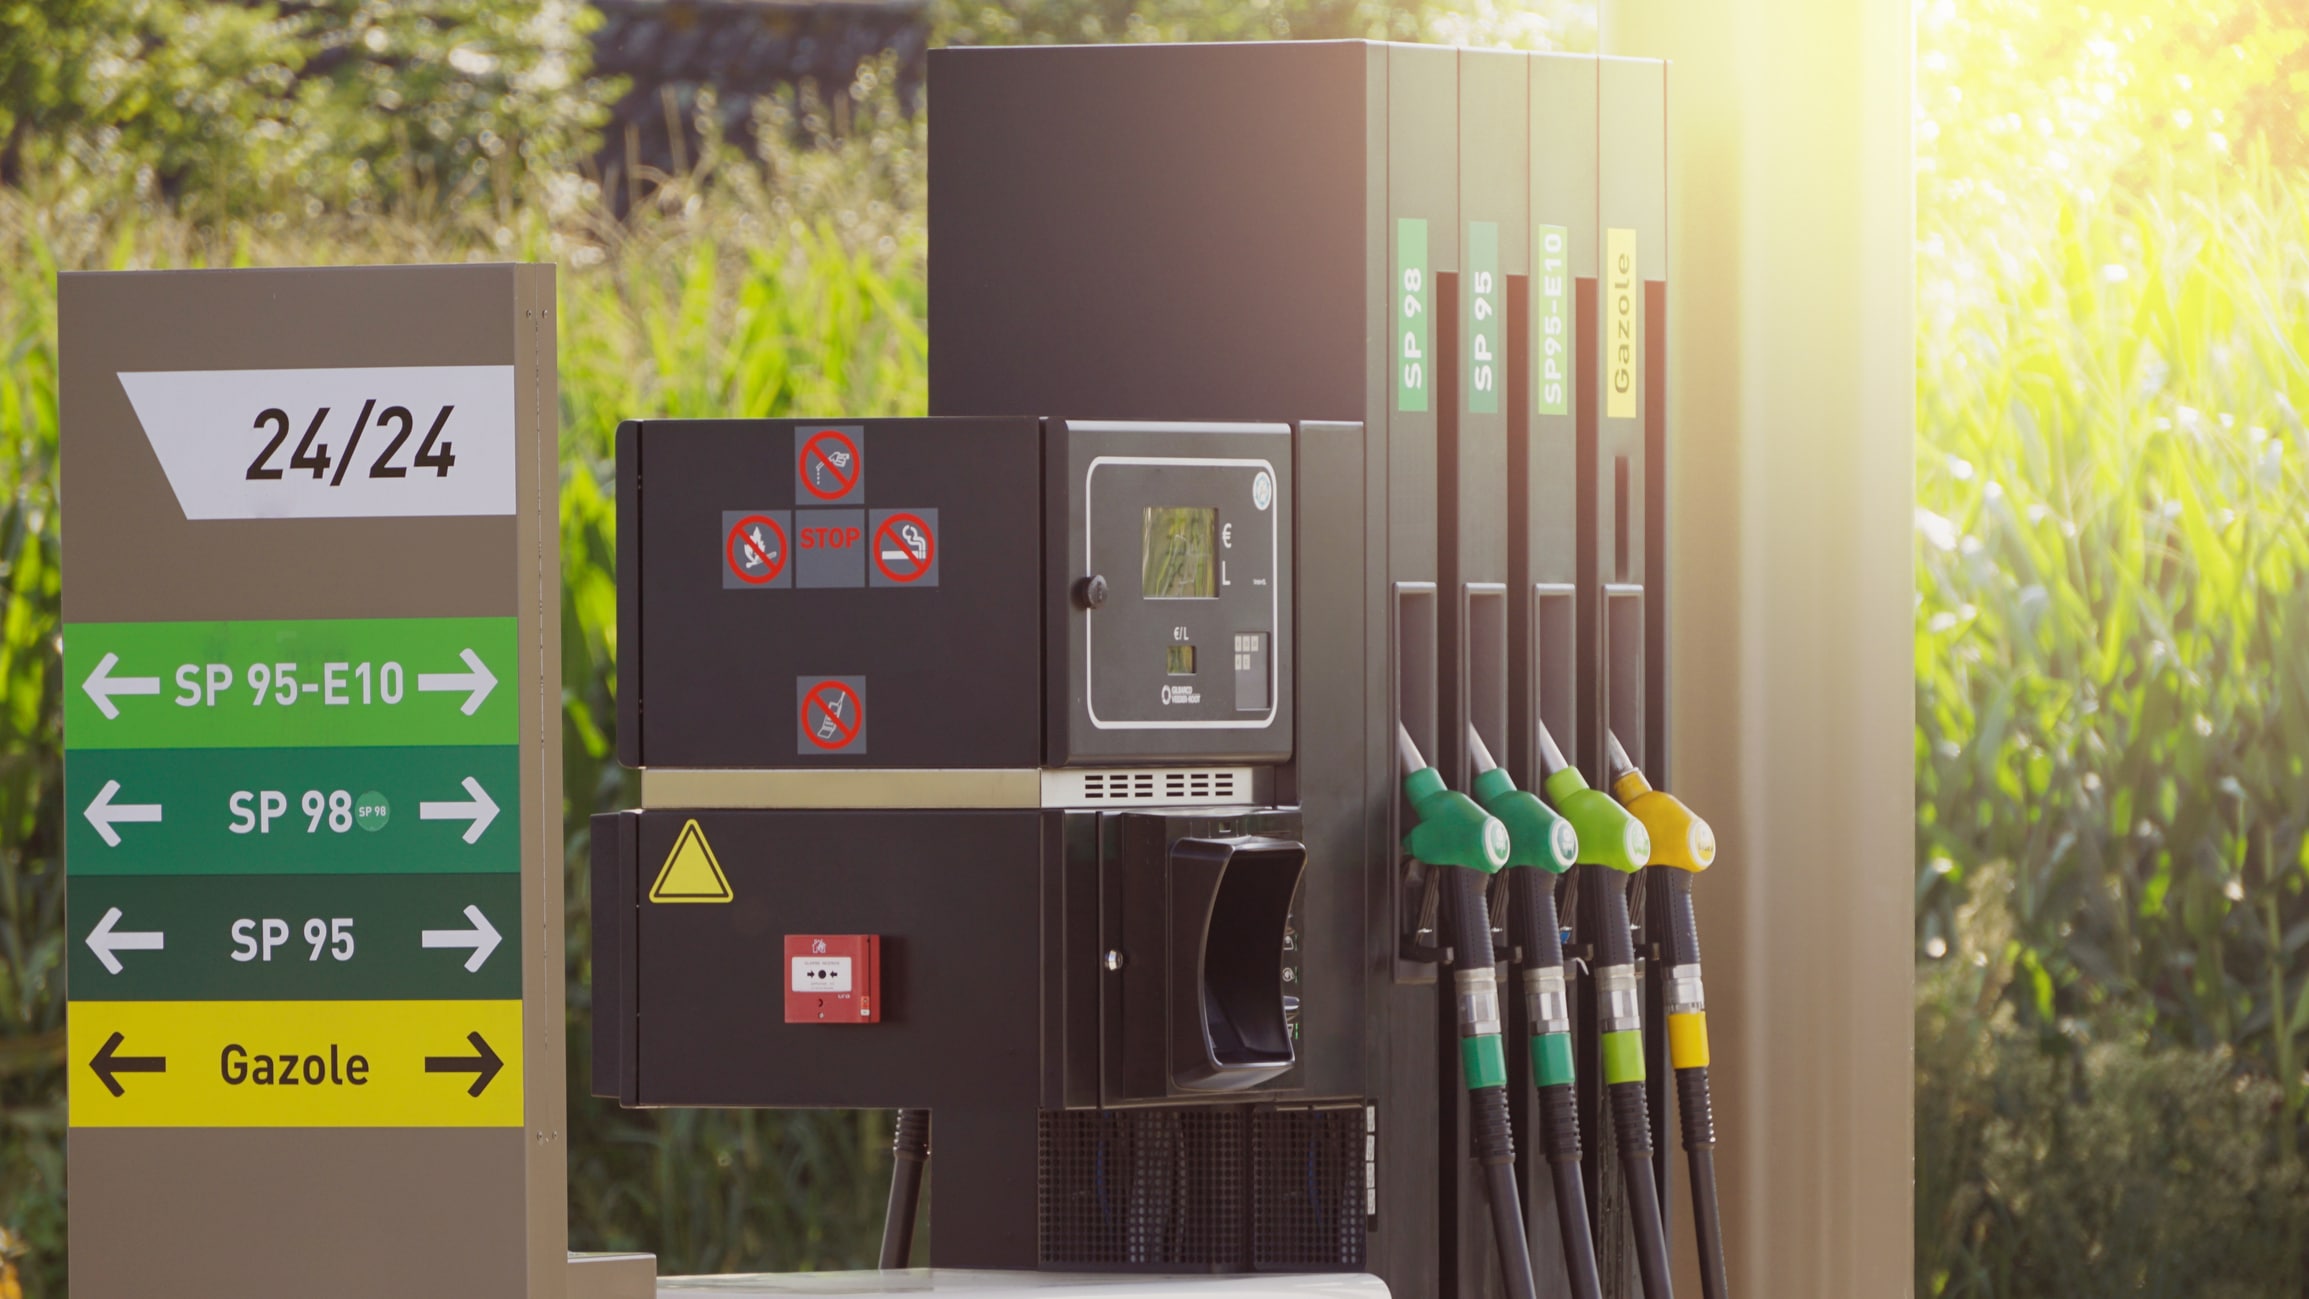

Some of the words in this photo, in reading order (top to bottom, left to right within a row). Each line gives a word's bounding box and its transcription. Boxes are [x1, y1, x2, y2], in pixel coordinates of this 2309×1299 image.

[1404, 267, 1422, 318] 98
[1474, 271, 1493, 321] 95
[1544, 233, 1562, 404] SP95-E10
[1614, 253, 1631, 394] Gazole
[1404, 331, 1422, 389] SP
[1474, 333, 1493, 392] SP
[246, 399, 456, 486] 24/24
[800, 526, 861, 549] STOP
[1222, 523, 1232, 548] €
[1222, 561, 1231, 585] L
[175, 663, 233, 706] SP
[247, 661, 404, 706] 95-E10
[229, 790, 287, 833] SP
[301, 790, 352, 833] 98
[359, 806, 372, 817] SP
[374, 805, 386, 817] 98
[230, 918, 289, 961] SP
[304, 918, 355, 961] 95
[220, 1043, 370, 1085] Gazole
